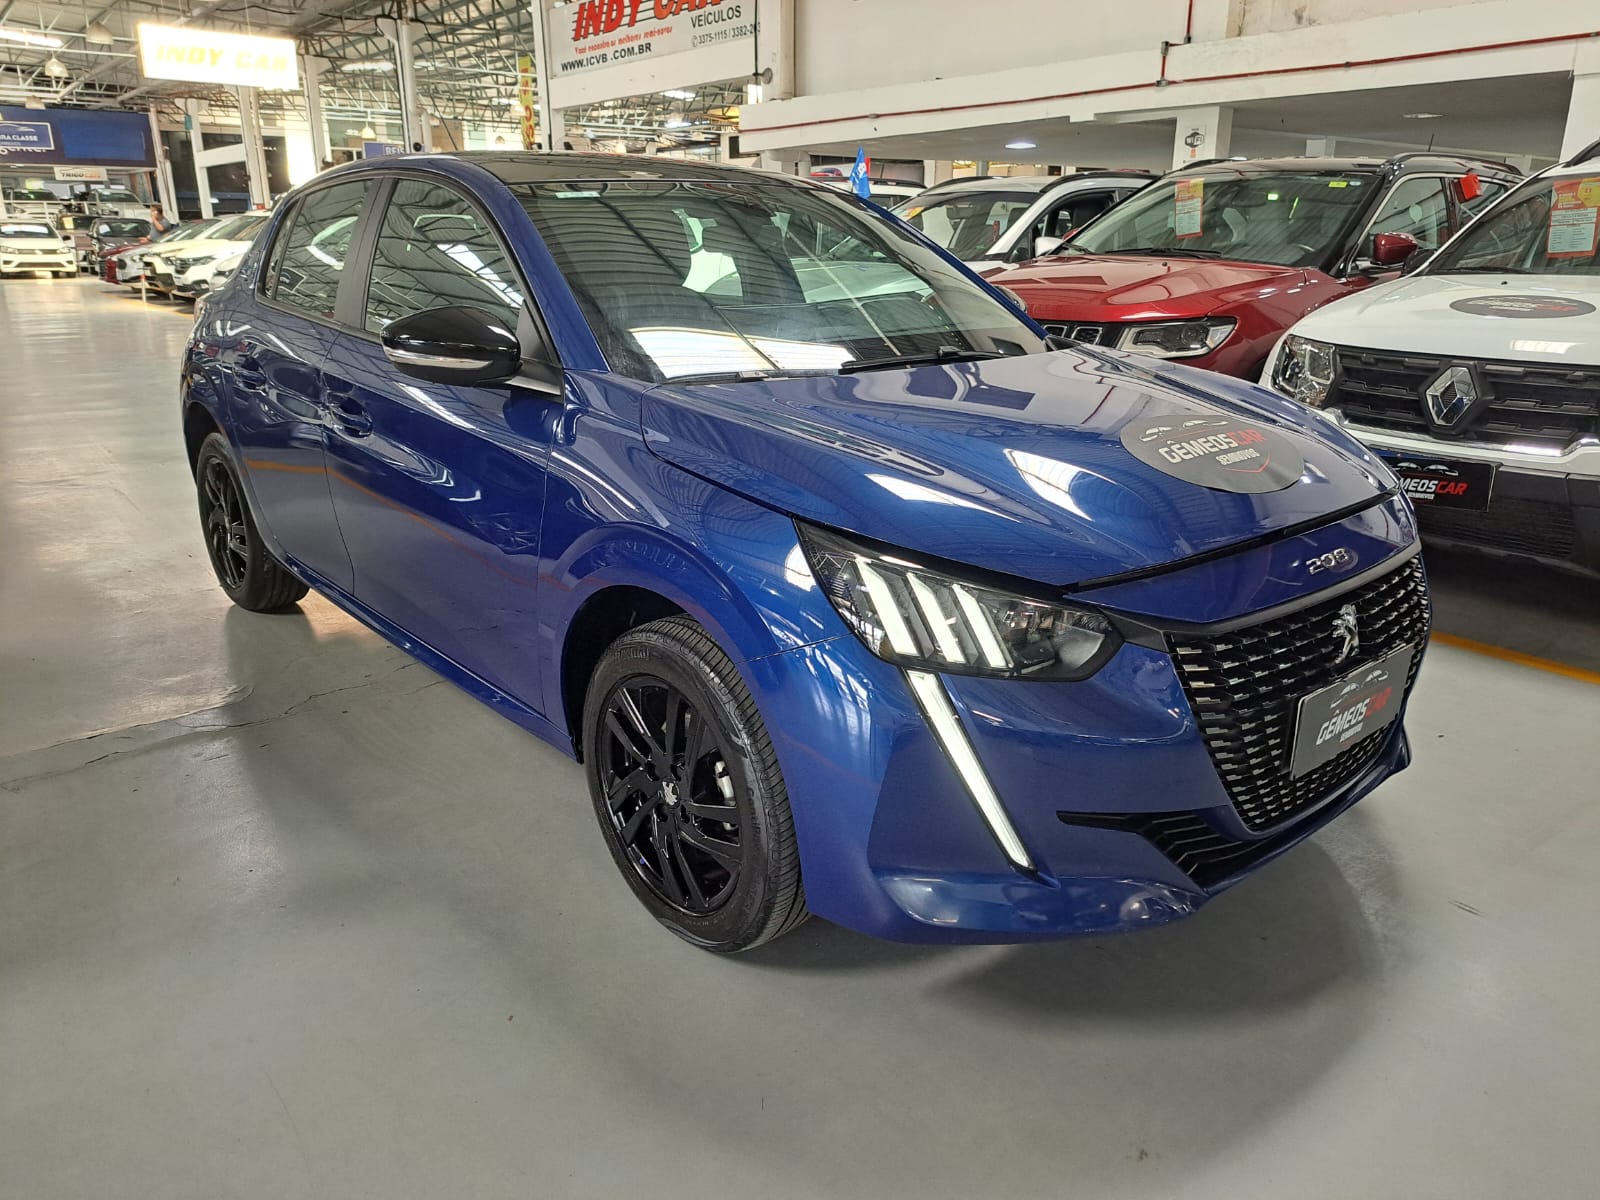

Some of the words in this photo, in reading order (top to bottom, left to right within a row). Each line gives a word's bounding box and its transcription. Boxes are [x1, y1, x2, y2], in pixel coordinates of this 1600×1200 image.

[571, 0, 642, 42] INDY
[690, 5, 742, 28] VEÍCULOS
[156, 43, 224, 66] INDY
[235, 50, 288, 73] CAR
[1305, 548, 1349, 575] 208
